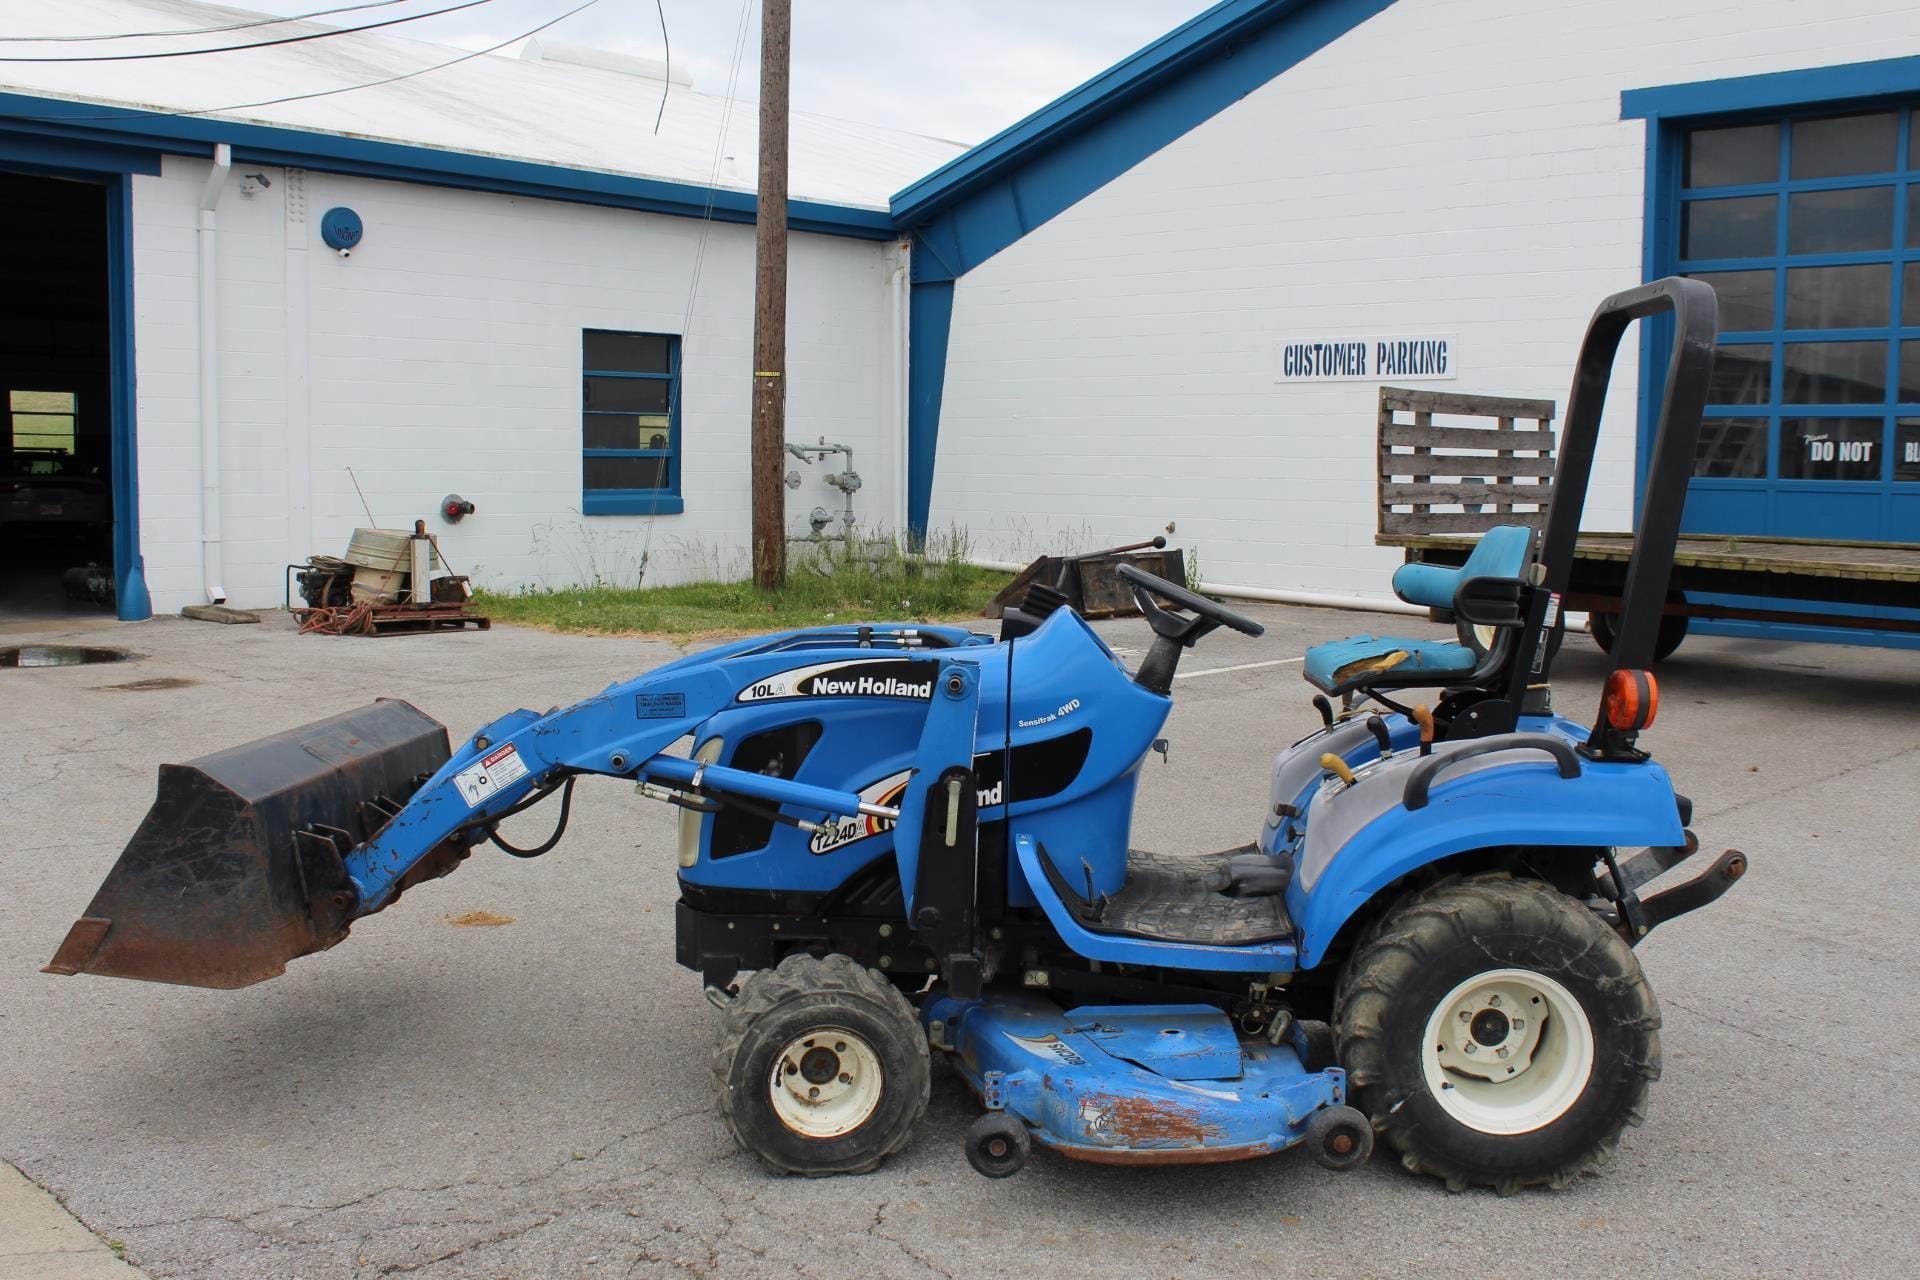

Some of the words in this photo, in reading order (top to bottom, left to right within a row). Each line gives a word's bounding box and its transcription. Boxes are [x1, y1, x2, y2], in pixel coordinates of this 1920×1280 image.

[1283, 342, 1366, 377] CUSTOMER
[1376, 340, 1447, 376] PARKING
[1811, 441, 1834, 462] DO
[1839, 442, 1873, 462] NOT
[812, 677, 857, 695] New
[858, 677, 932, 698] Holland
[1018, 713, 1057, 728] Sensitrak
[1057, 698, 1081, 716] 4WD
